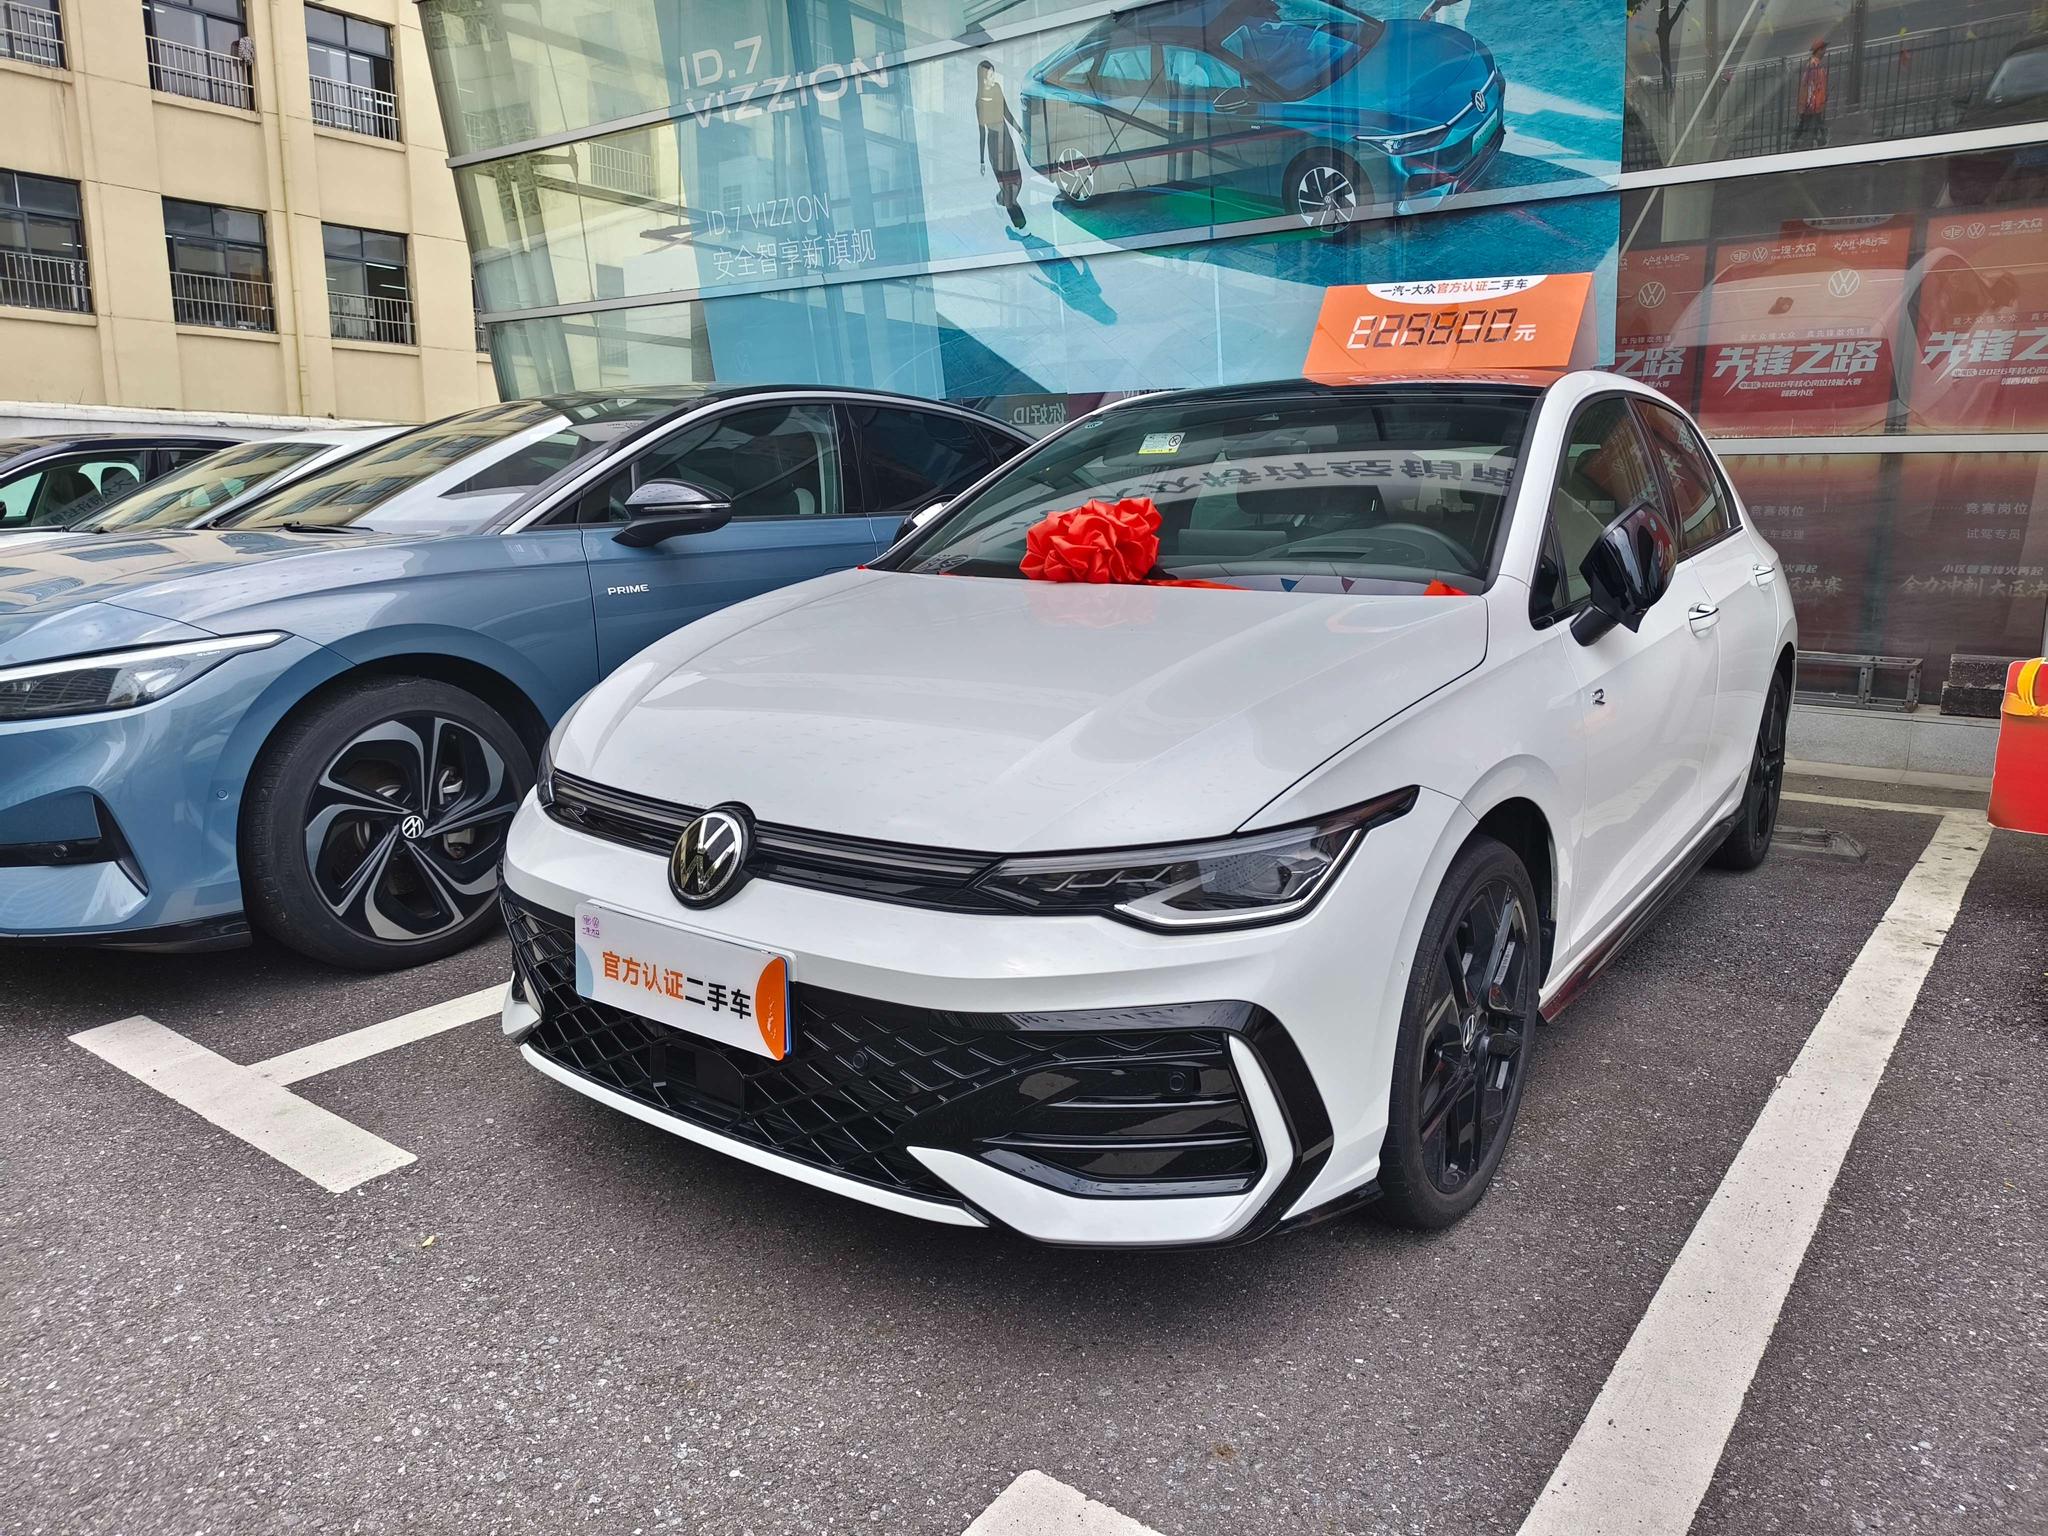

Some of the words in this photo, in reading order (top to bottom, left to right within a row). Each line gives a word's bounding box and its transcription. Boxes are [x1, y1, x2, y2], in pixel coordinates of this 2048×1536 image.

[678, 35, 763, 91] ID.7
[686, 51, 889, 129] VIZZION
[706, 207, 742, 237] ID.7
[748, 192, 830, 231] VIZZION
[712, 228, 877, 281] 安全智享新旗舰
[1712, 340, 1882, 397] 先锋之路
[607, 584, 650, 596] PRIME
[602, 950, 752, 1020] 官方认证二手车
